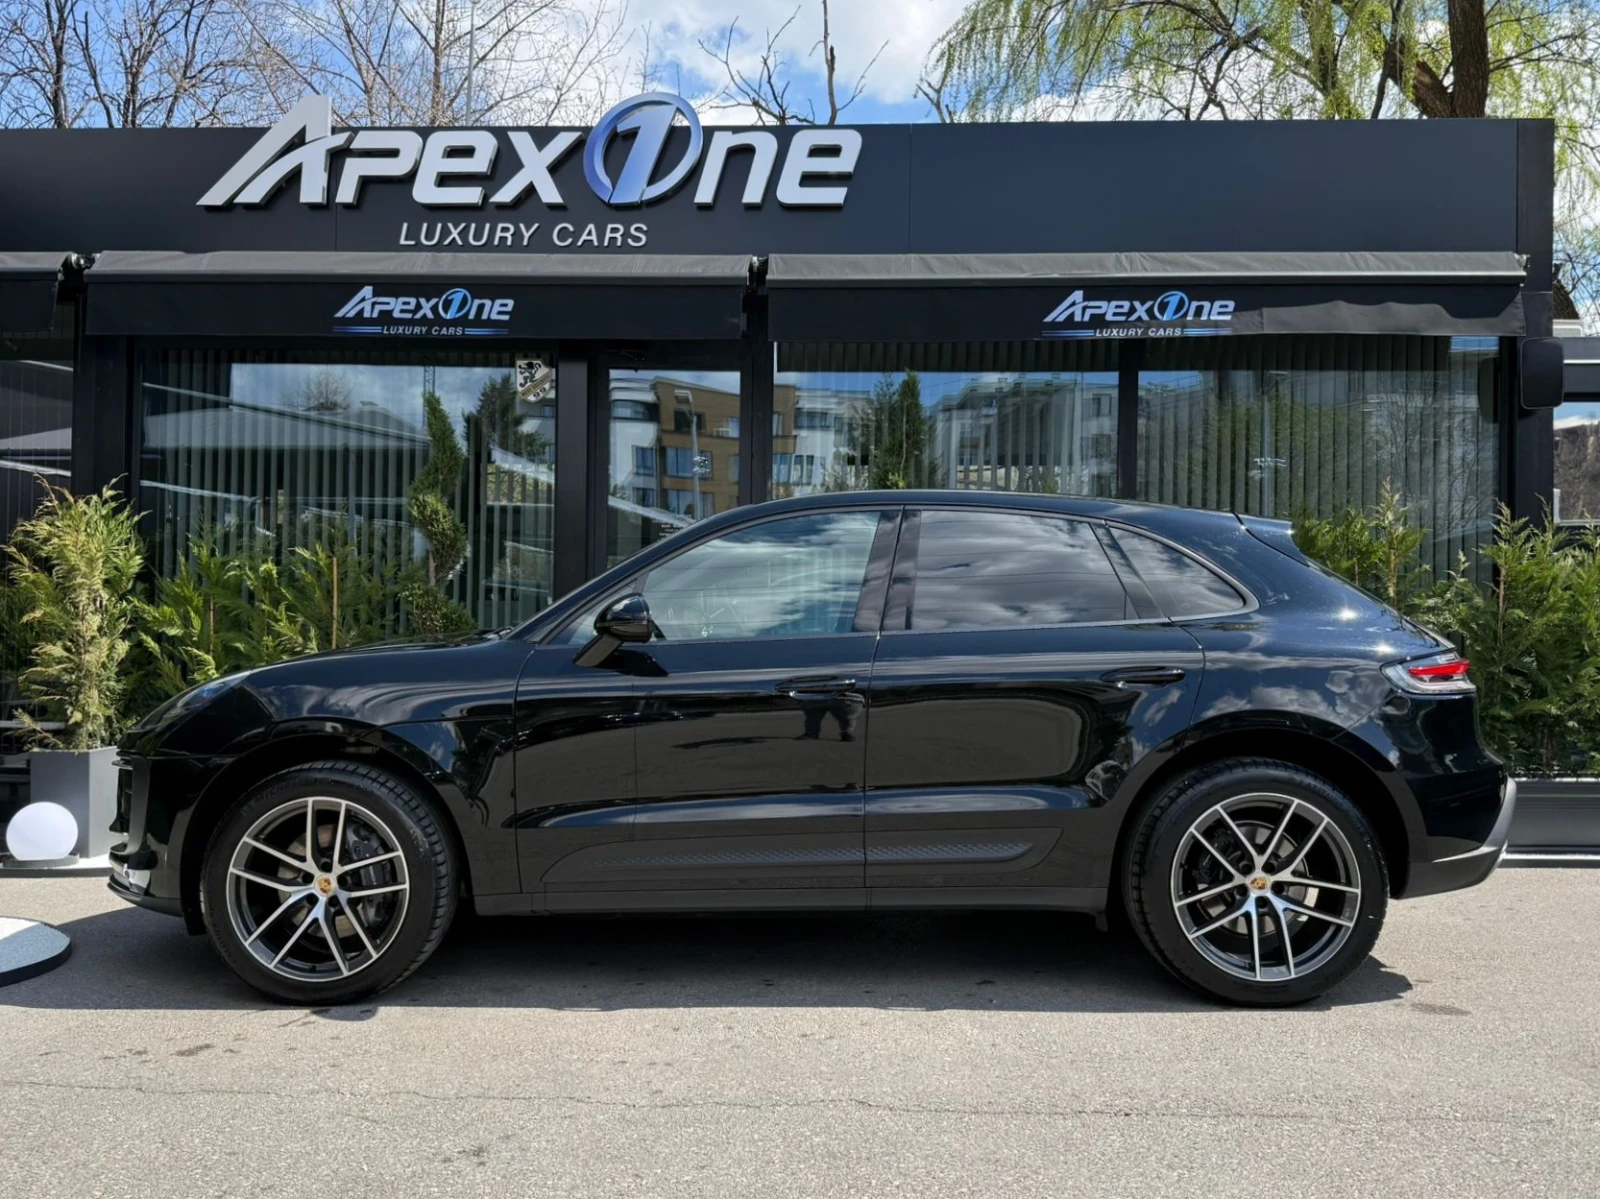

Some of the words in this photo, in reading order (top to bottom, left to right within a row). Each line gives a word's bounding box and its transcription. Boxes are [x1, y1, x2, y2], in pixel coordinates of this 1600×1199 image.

[399, 222, 540, 247] LUXURY
[552, 223, 649, 247] CARS
[383, 325, 428, 335] LUXURY
[431, 326, 464, 336] CARS
[1095, 327, 1145, 337] LUXURY
[1147, 327, 1182, 337] CARS
